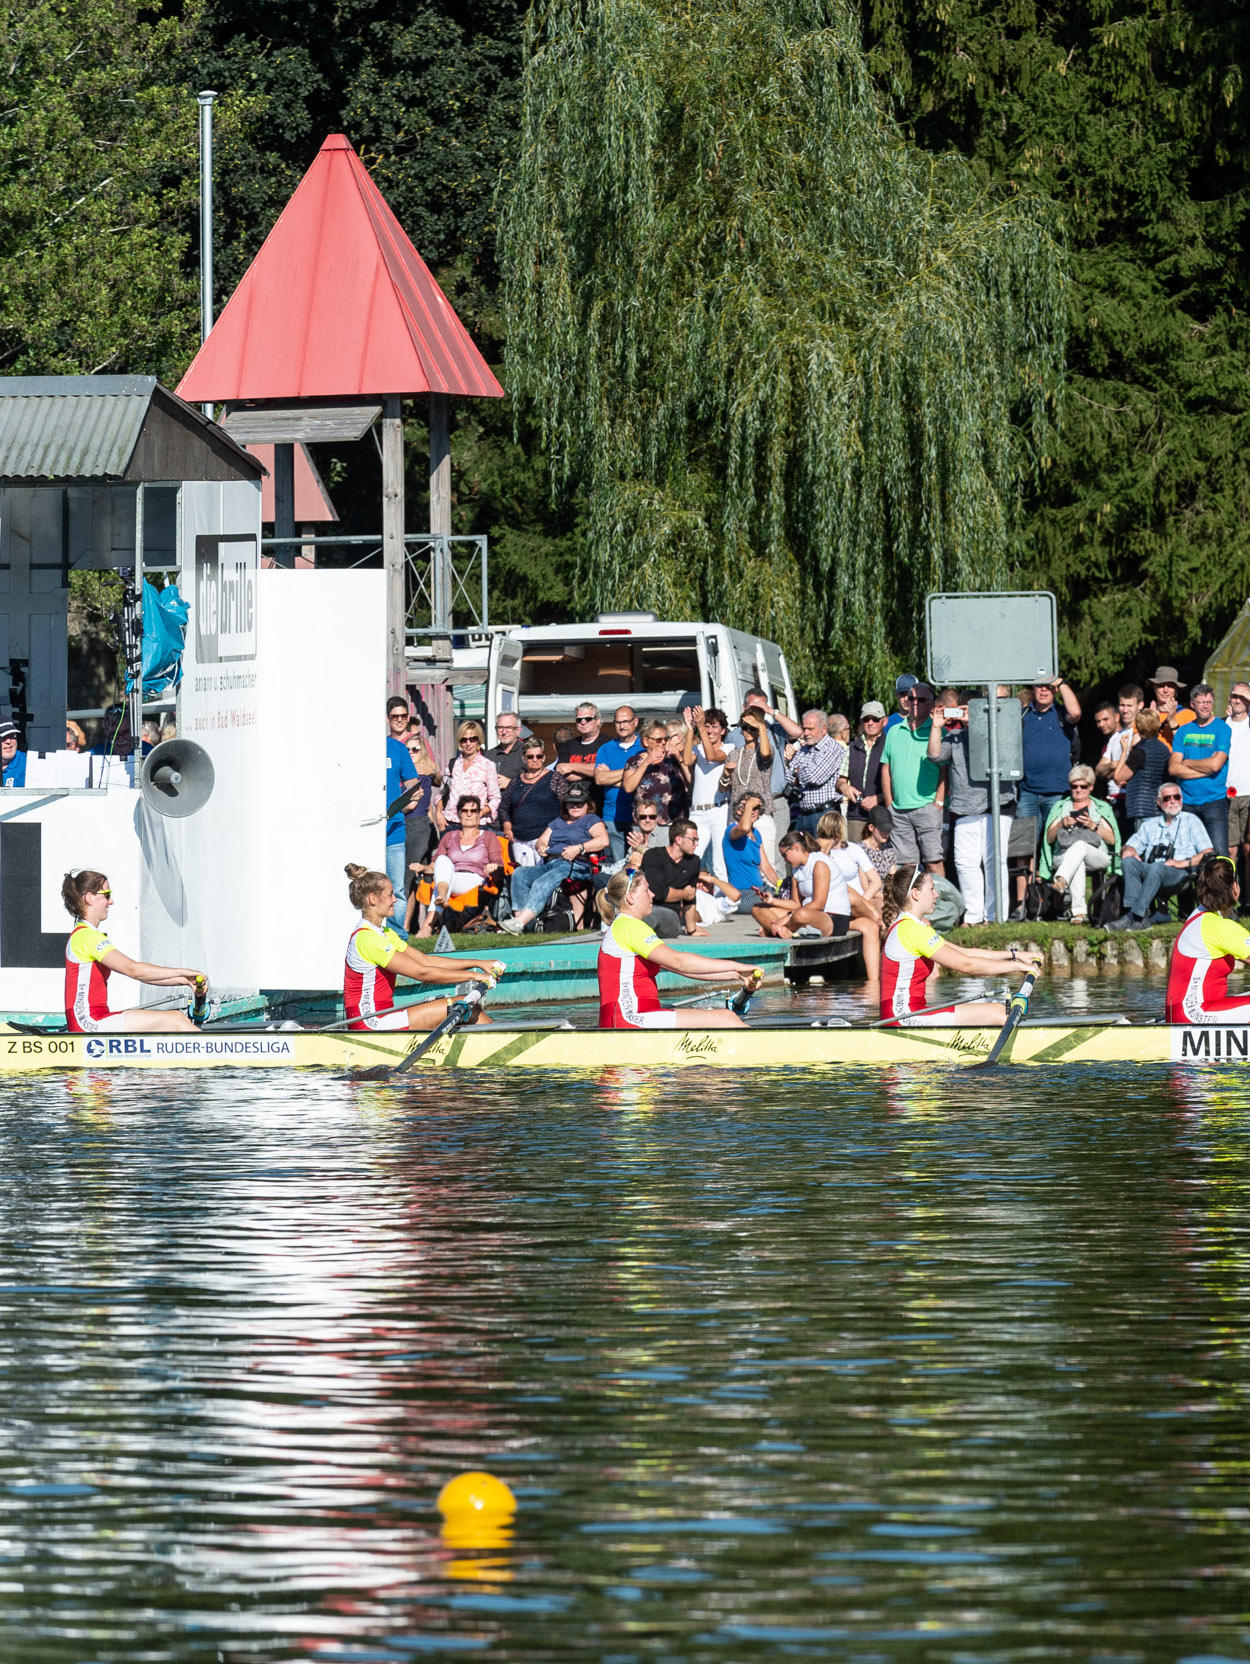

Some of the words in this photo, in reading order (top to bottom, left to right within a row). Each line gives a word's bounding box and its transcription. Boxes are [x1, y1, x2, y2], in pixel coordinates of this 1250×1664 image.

[199, 562, 217, 635] die
[220, 561, 253, 635] brille
[8, 1042, 17, 1054] Z
[23, 1041, 42, 1054] BS
[48, 1041, 75, 1054] 001
[109, 1038, 152, 1053] RBL
[157, 1041, 290, 1055] RUDER-BUNDESLIGA
[403, 1034, 447, 1055] Mitta
[672, 1032, 720, 1053] Melitta
[946, 1030, 992, 1051] Melitta
